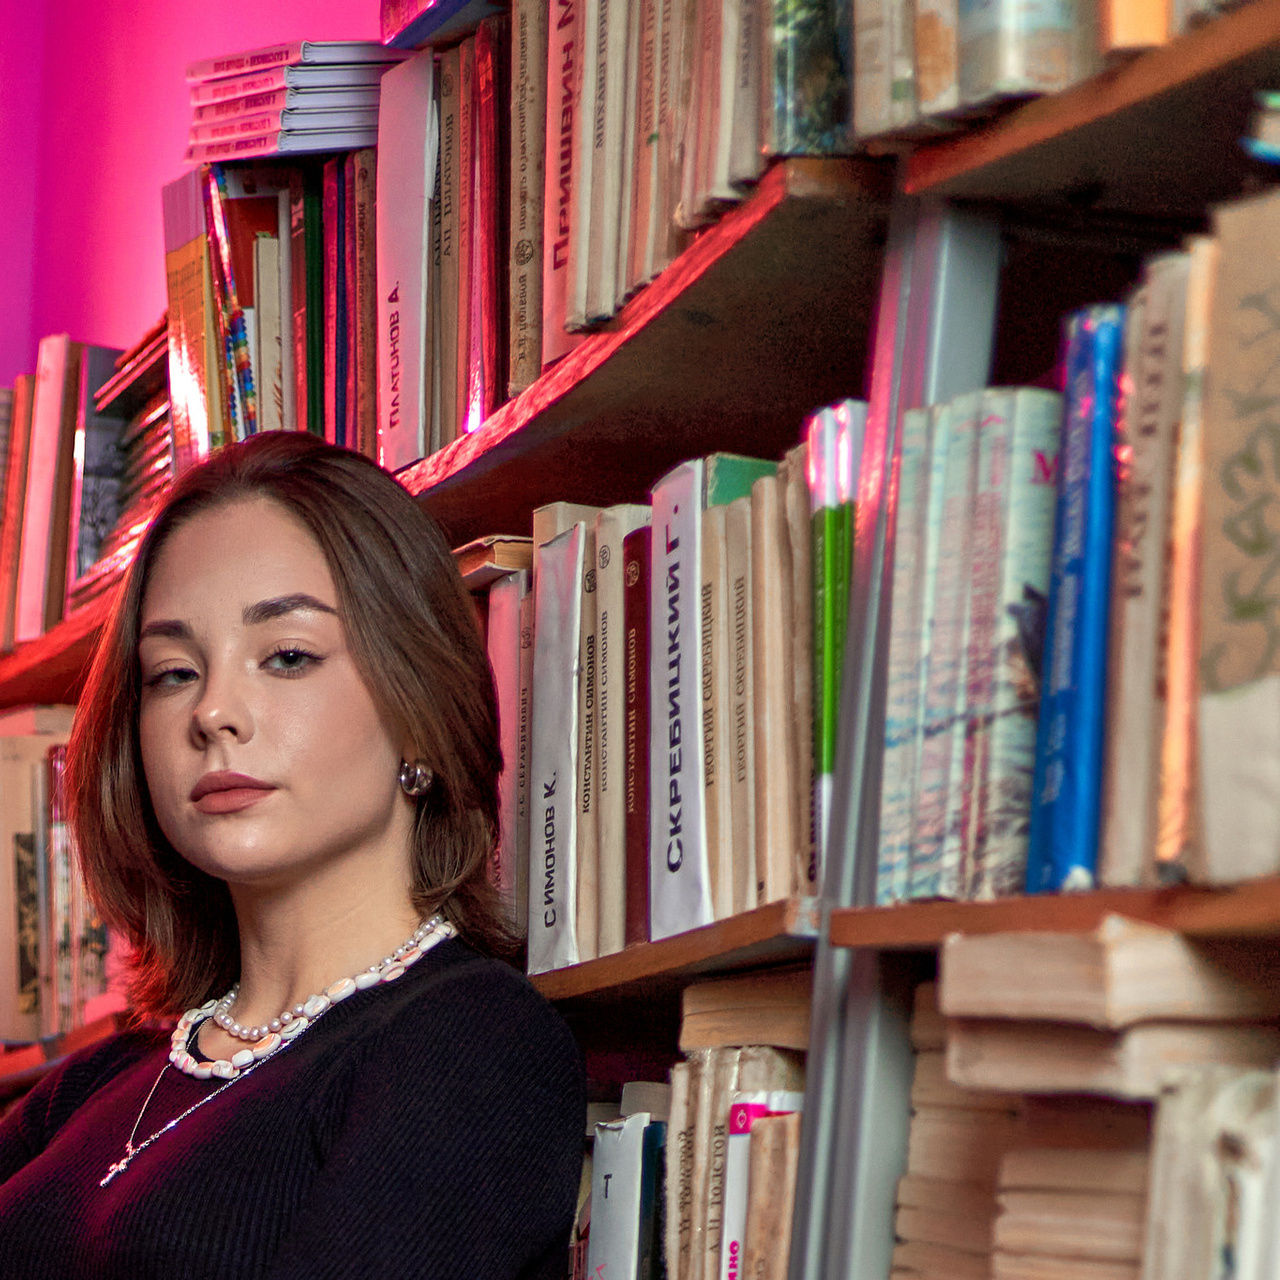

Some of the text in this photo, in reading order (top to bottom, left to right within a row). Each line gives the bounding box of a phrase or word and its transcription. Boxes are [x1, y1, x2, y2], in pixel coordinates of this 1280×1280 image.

[595, 61, 607, 149] МИХАИЛ
[643, 39, 654, 132] МИХАИЛ
[659, 31, 671, 124] МИХАИЛ
[442, 112, 455, 215] ПЛАТОНОВ
[553, 38, 573, 270] Пришвин
[386, 279, 400, 303] А.
[519, 687, 528, 788] СЕРАФИМОВИЧ
[582, 634, 596, 814] КОНСТАНТИН СИМОНОВ
[600, 611, 609, 792] КОНСТАНТИН СИМОНОВ
[626, 627, 637, 814] КОНСТАНТИН СИМОНОВ
[700, 582, 714, 788] ГЕОРГИЙ СКРЕБИЦКИЙ
[732, 575, 746, 783] ГЕОРГИЙ СКРЕБИЦКИЙ
[542, 771, 557, 929] СИМОНОВ К.
[708, 1125, 726, 1206] ТОЛСТОЙ
